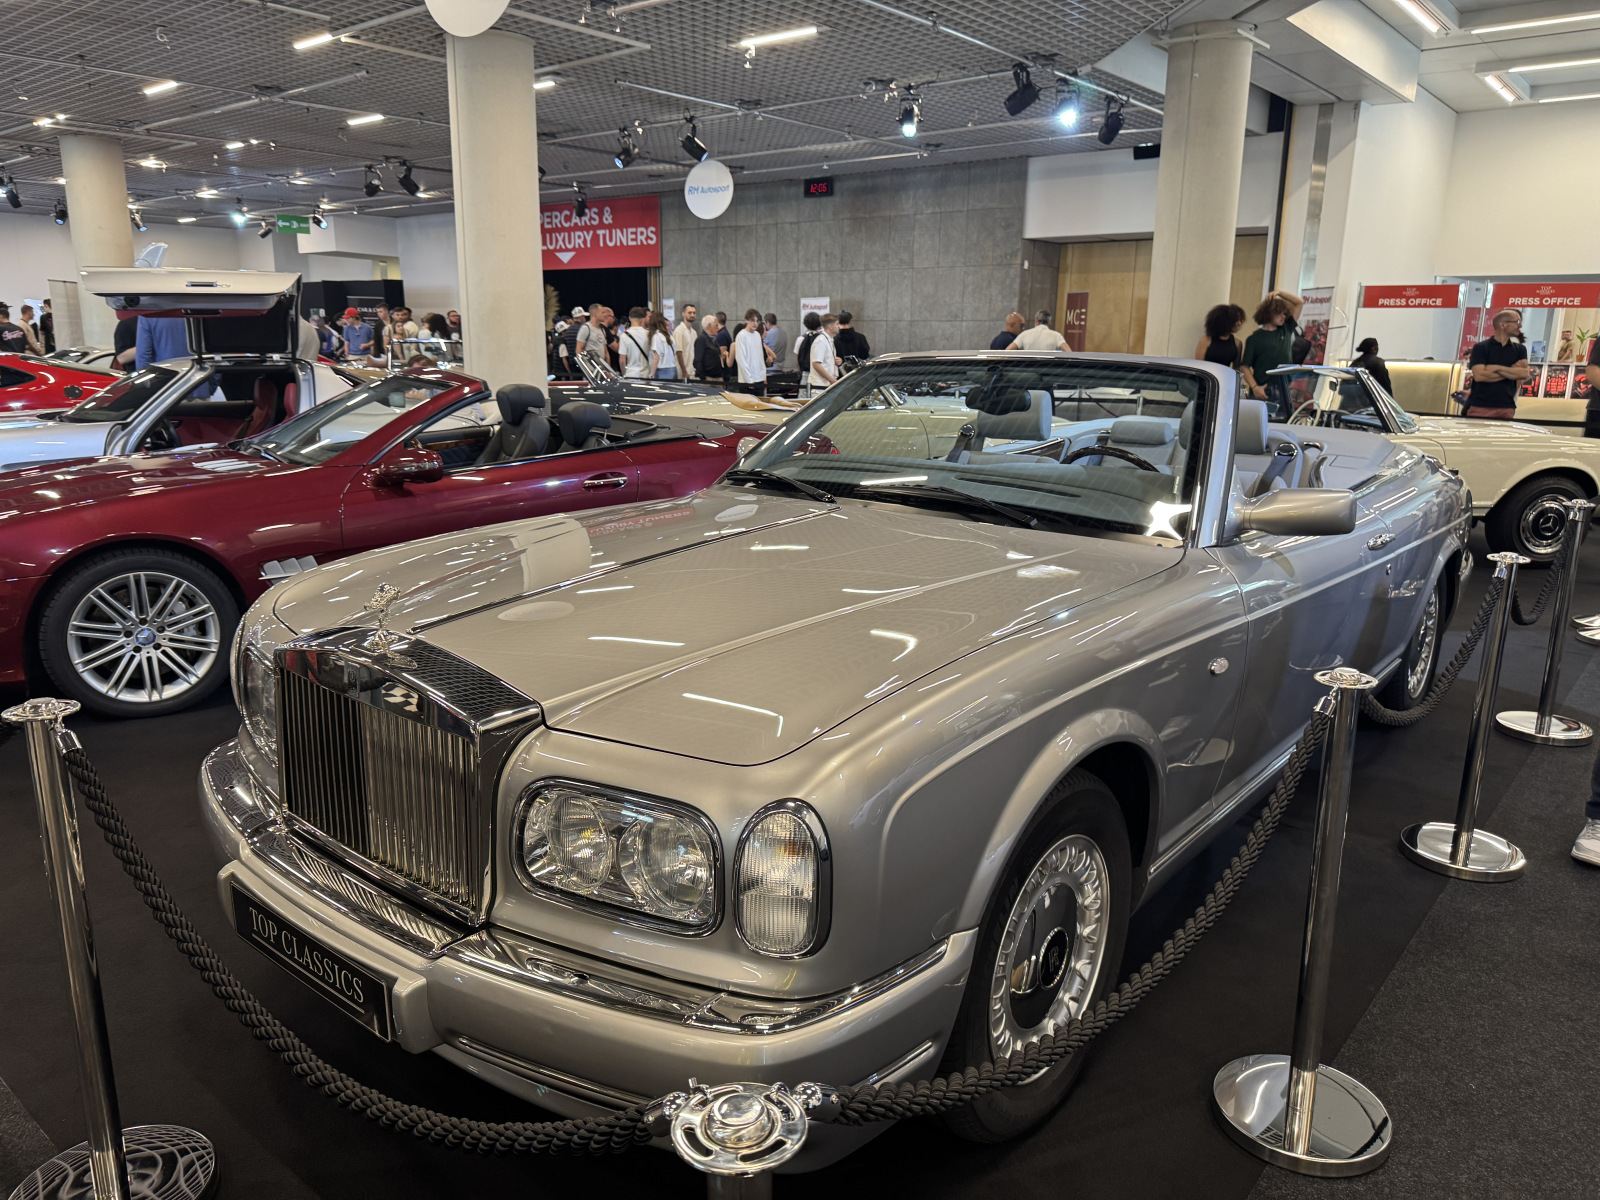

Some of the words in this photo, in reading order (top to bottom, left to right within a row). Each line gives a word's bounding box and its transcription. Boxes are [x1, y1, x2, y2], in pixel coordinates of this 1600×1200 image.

[602, 206, 613, 225] &
[596, 226, 657, 248] TUNERS
[1378, 298, 1406, 306] PRESS
[1408, 298, 1443, 306] OFFICE
[1508, 297, 1540, 306] PRESS
[1542, 297, 1582, 305] OFFICE
[1066, 308, 1086, 326] MCE
[248, 906, 278, 944] TOP
[281, 930, 364, 1004] CLASSICS
